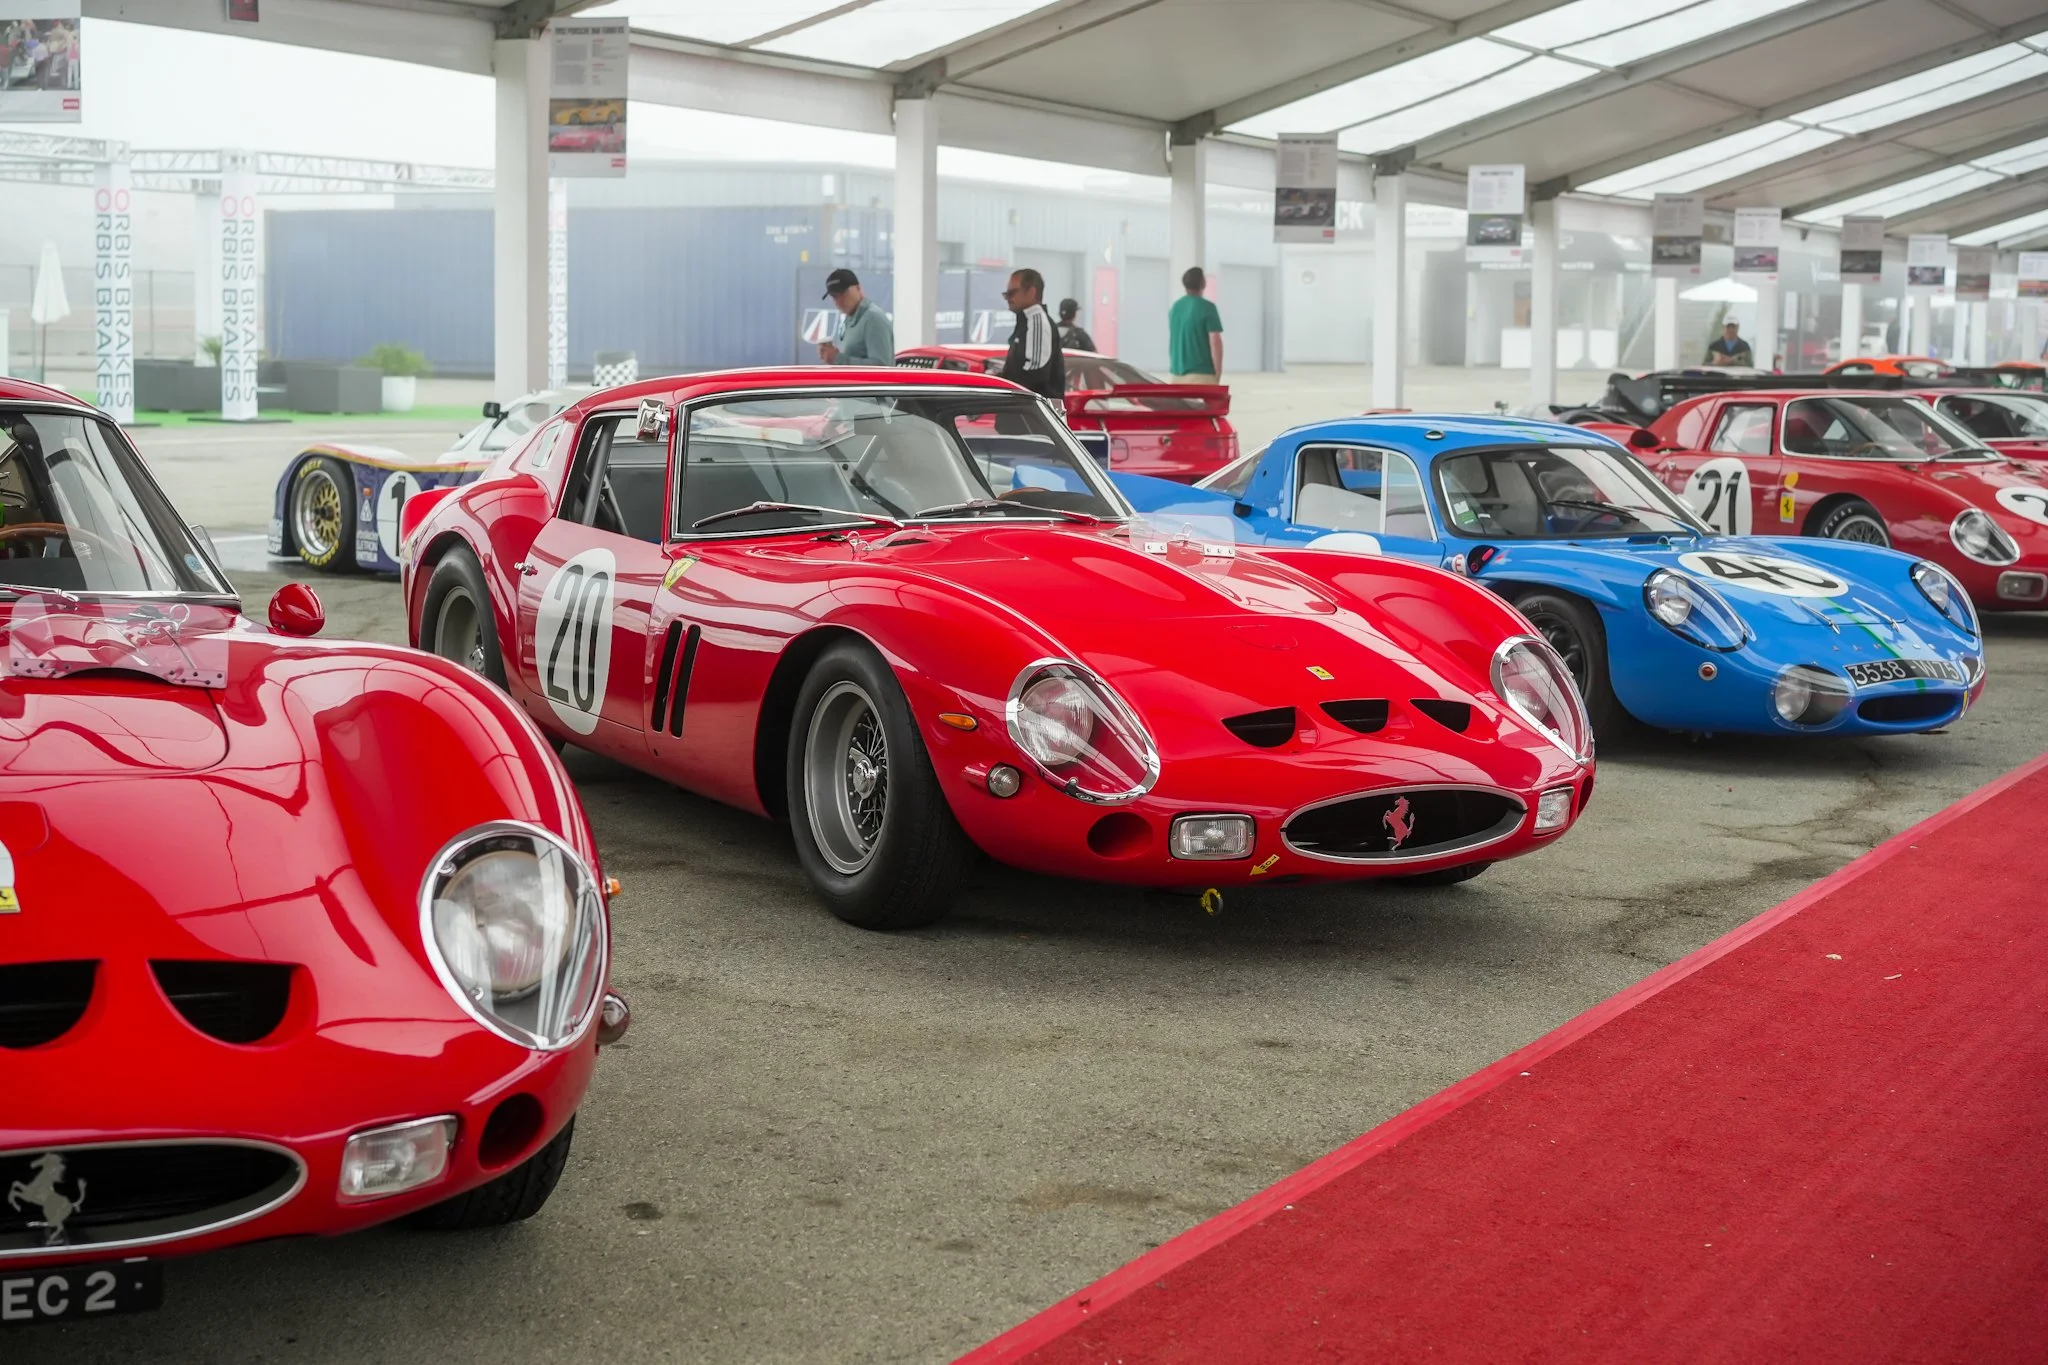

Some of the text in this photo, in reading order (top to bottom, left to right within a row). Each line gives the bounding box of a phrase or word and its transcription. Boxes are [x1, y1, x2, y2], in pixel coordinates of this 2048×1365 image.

[95, 188, 113, 408] ORBIS BRAKES
[114, 188, 131, 408] ORBIS BRAKES
[221, 196, 241, 402] ORBIS BRAKES
[240, 196, 258, 402] ORBIS BRAKES
[1695, 469, 1742, 536] 21
[1697, 555, 1839, 590] 46
[548, 564, 609, 712] 20
[84, 1271, 117, 1312] 2
